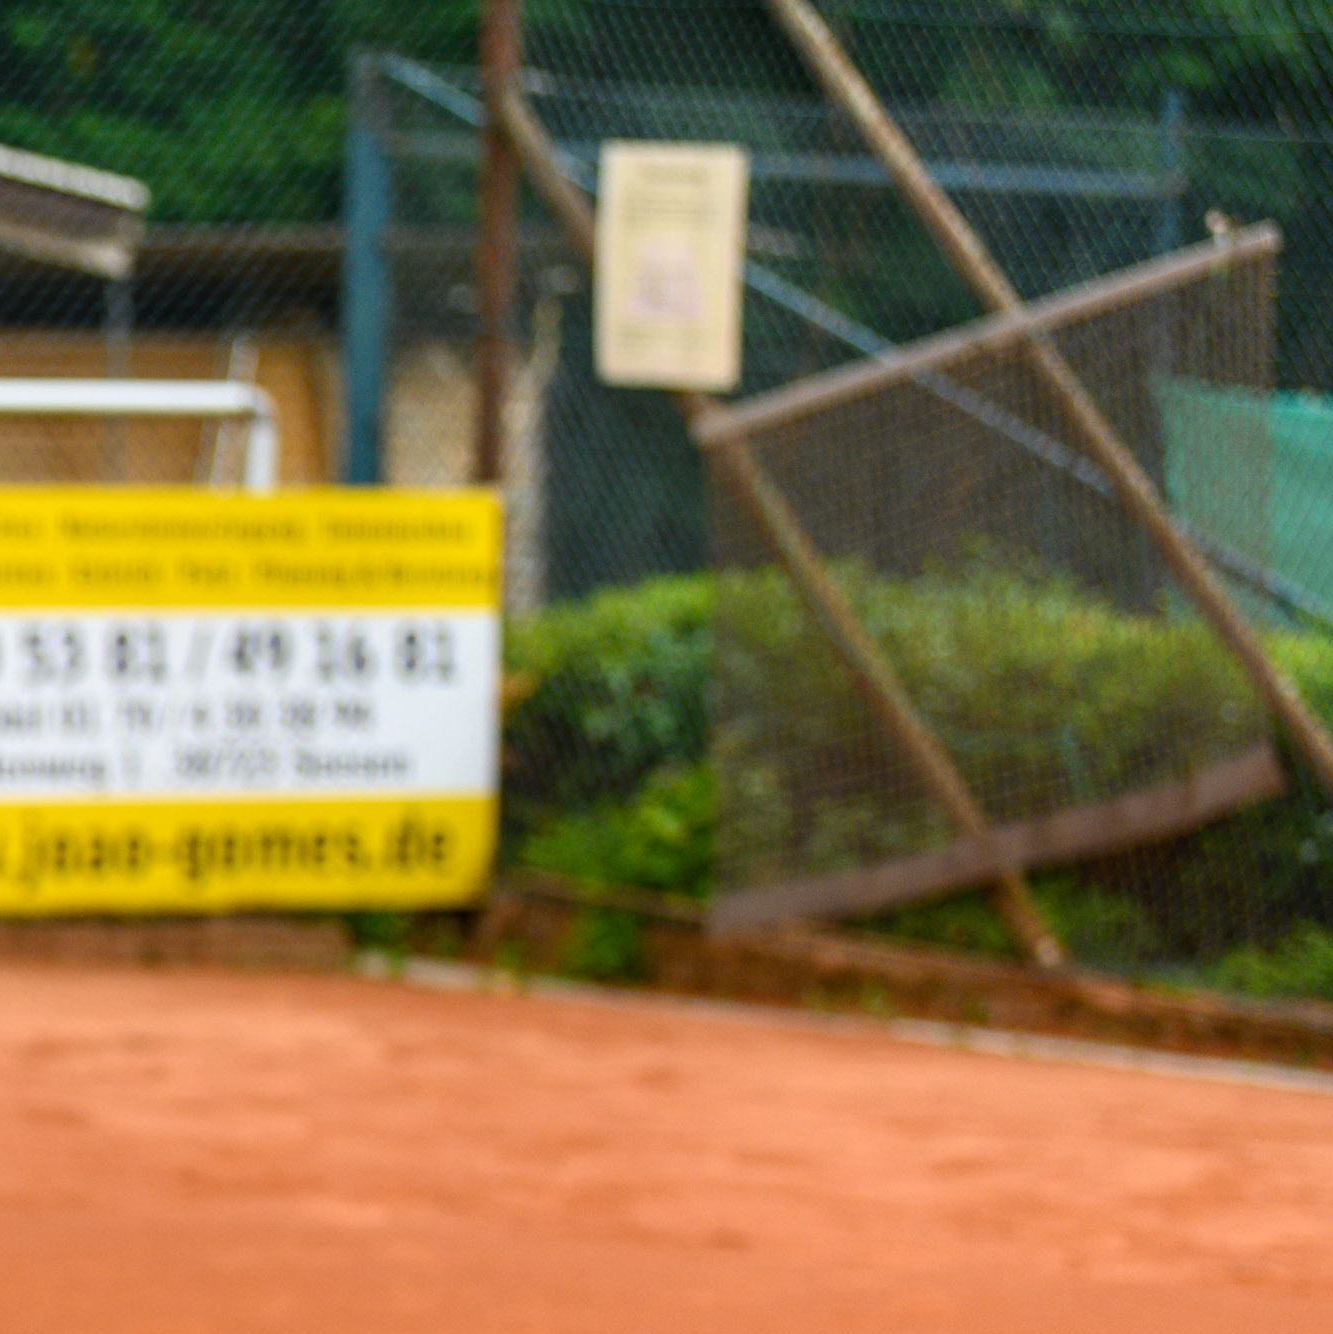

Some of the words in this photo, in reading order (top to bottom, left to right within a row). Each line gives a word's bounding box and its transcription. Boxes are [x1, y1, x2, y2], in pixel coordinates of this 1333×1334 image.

[17, 621, 90, 684] 53
[102, 620, 173, 683] 81
[183, 620, 217, 682] /
[223, 619, 293, 683] 49
[308, 619, 377, 682] 16
[393, 618, 463, 682] 81
